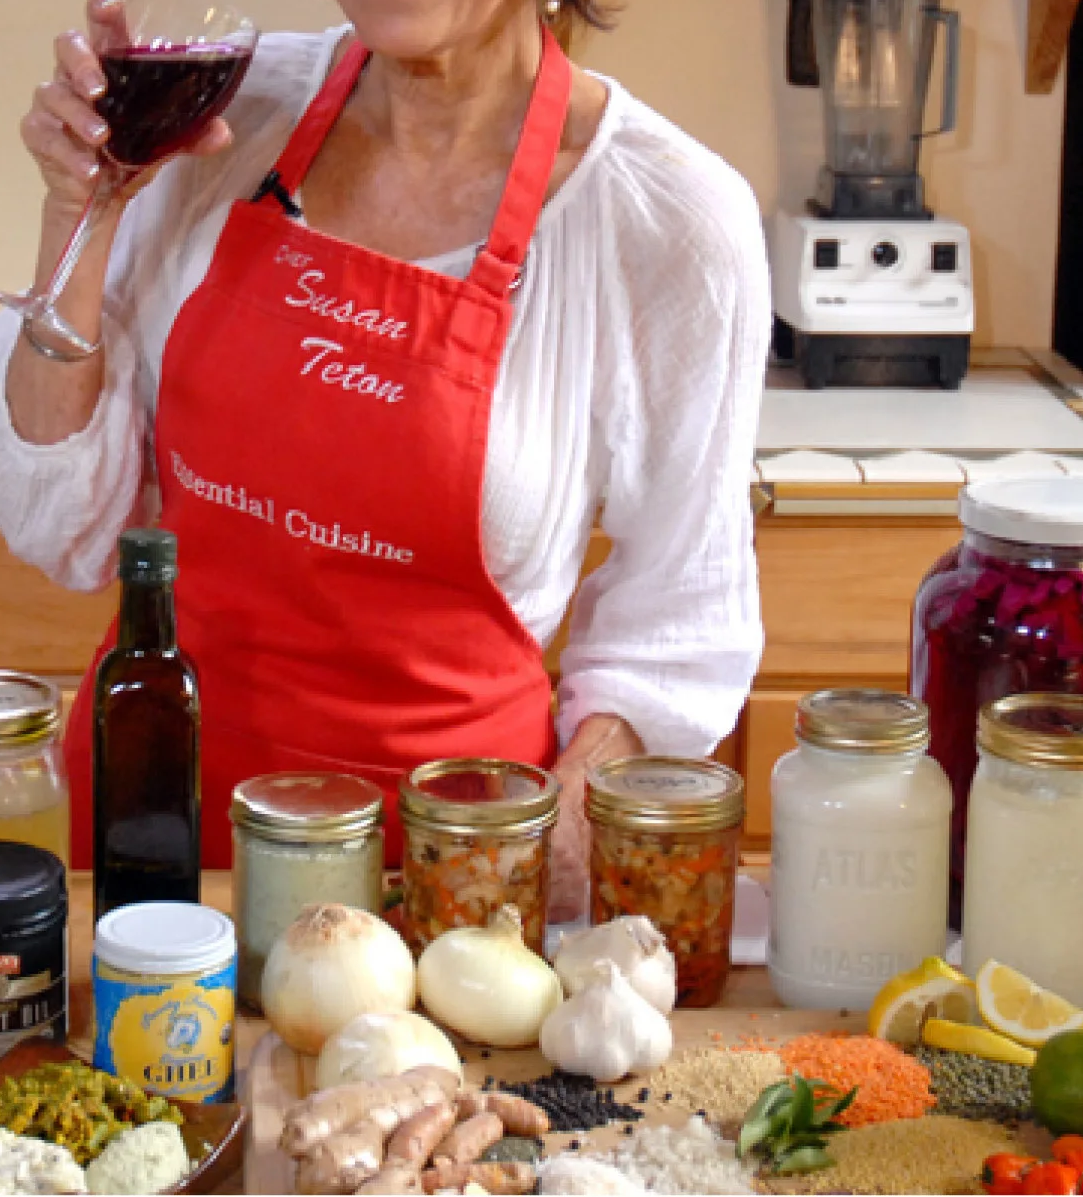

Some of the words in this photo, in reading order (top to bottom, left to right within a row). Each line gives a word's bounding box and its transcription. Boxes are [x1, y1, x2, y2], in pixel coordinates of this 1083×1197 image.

[285, 269, 408, 339] Susan
[300, 337, 405, 403] Teton
[284, 509, 414, 564] Cuisine
[811, 847, 917, 892] ATLAS
